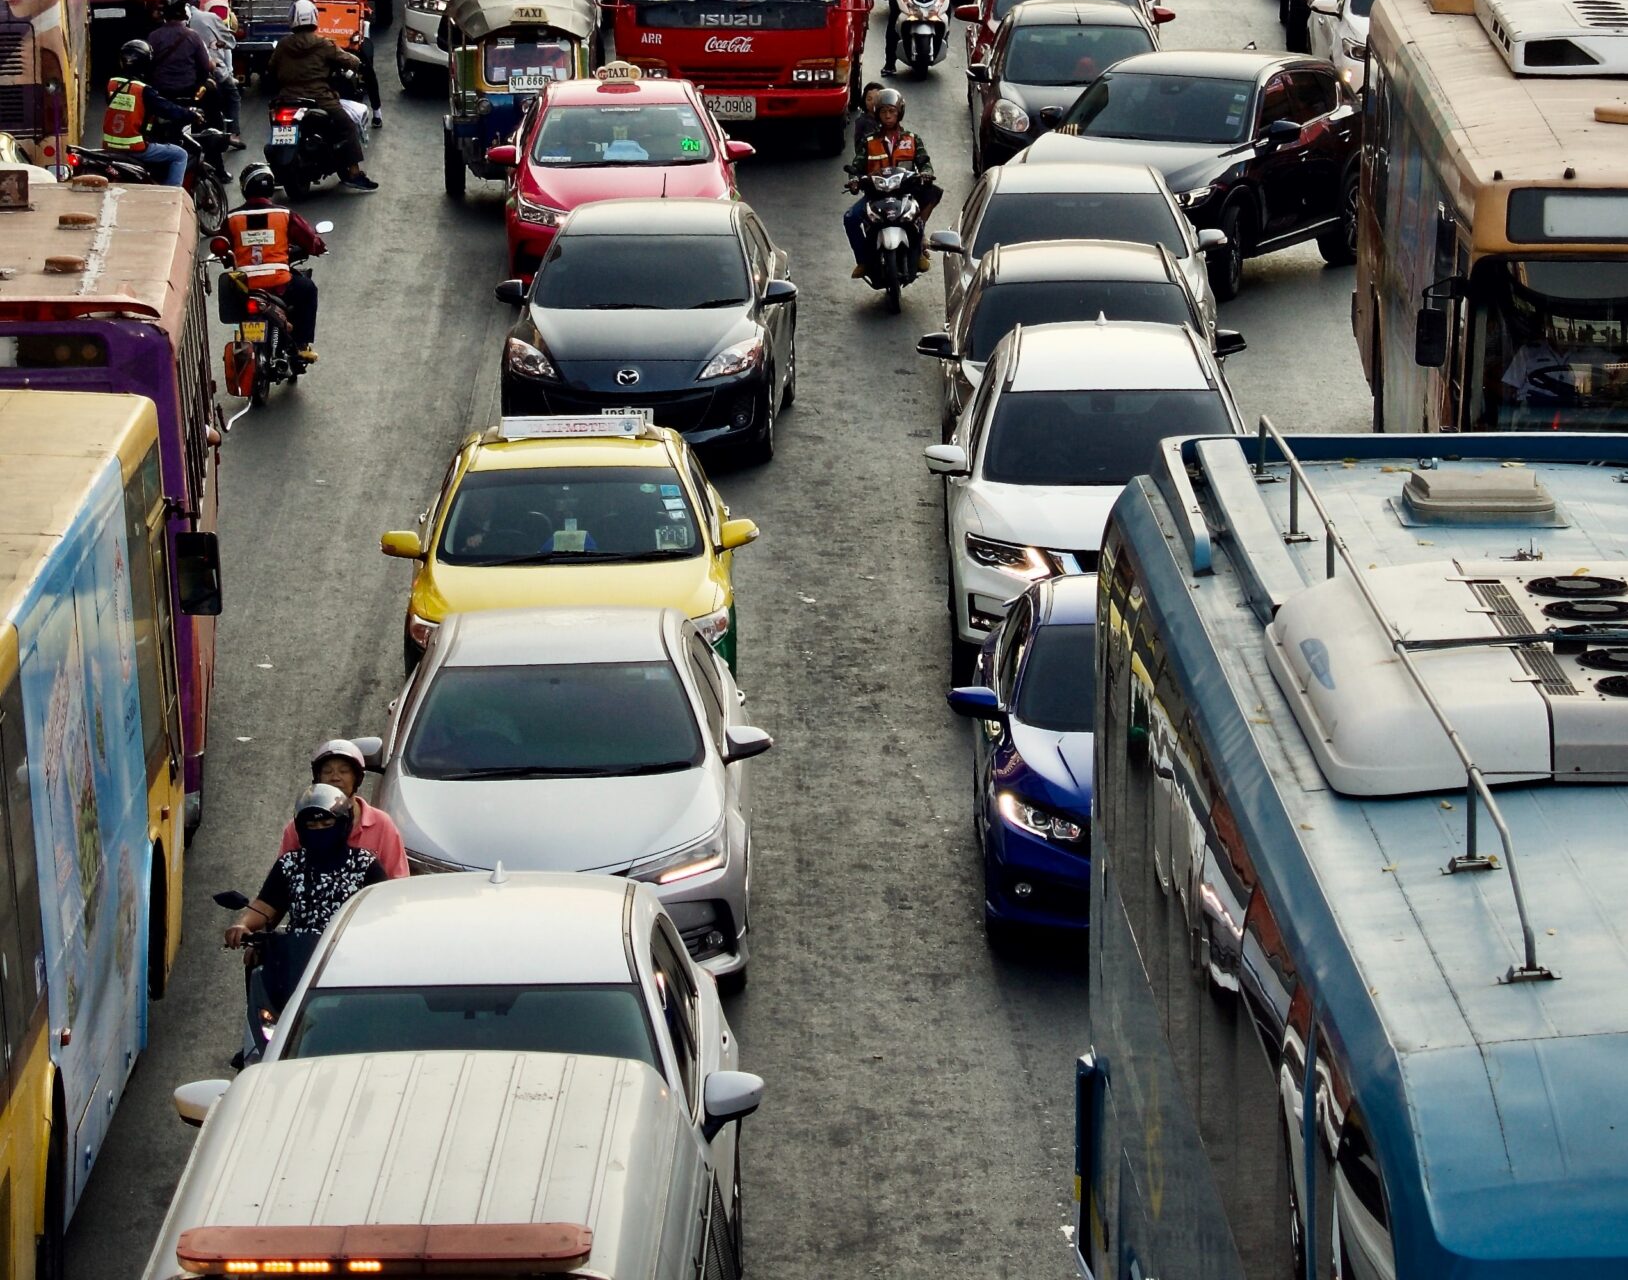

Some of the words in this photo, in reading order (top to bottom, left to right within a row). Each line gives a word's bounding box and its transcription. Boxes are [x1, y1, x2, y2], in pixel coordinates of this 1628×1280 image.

[518, 7, 543, 18] TAXI
[699, 13, 763, 26] ISUZU
[641, 32, 662, 45] ARR
[608, 67, 629, 78] TAXI
[112, 113, 125, 134] 5
[251, 246, 263, 265] 5
